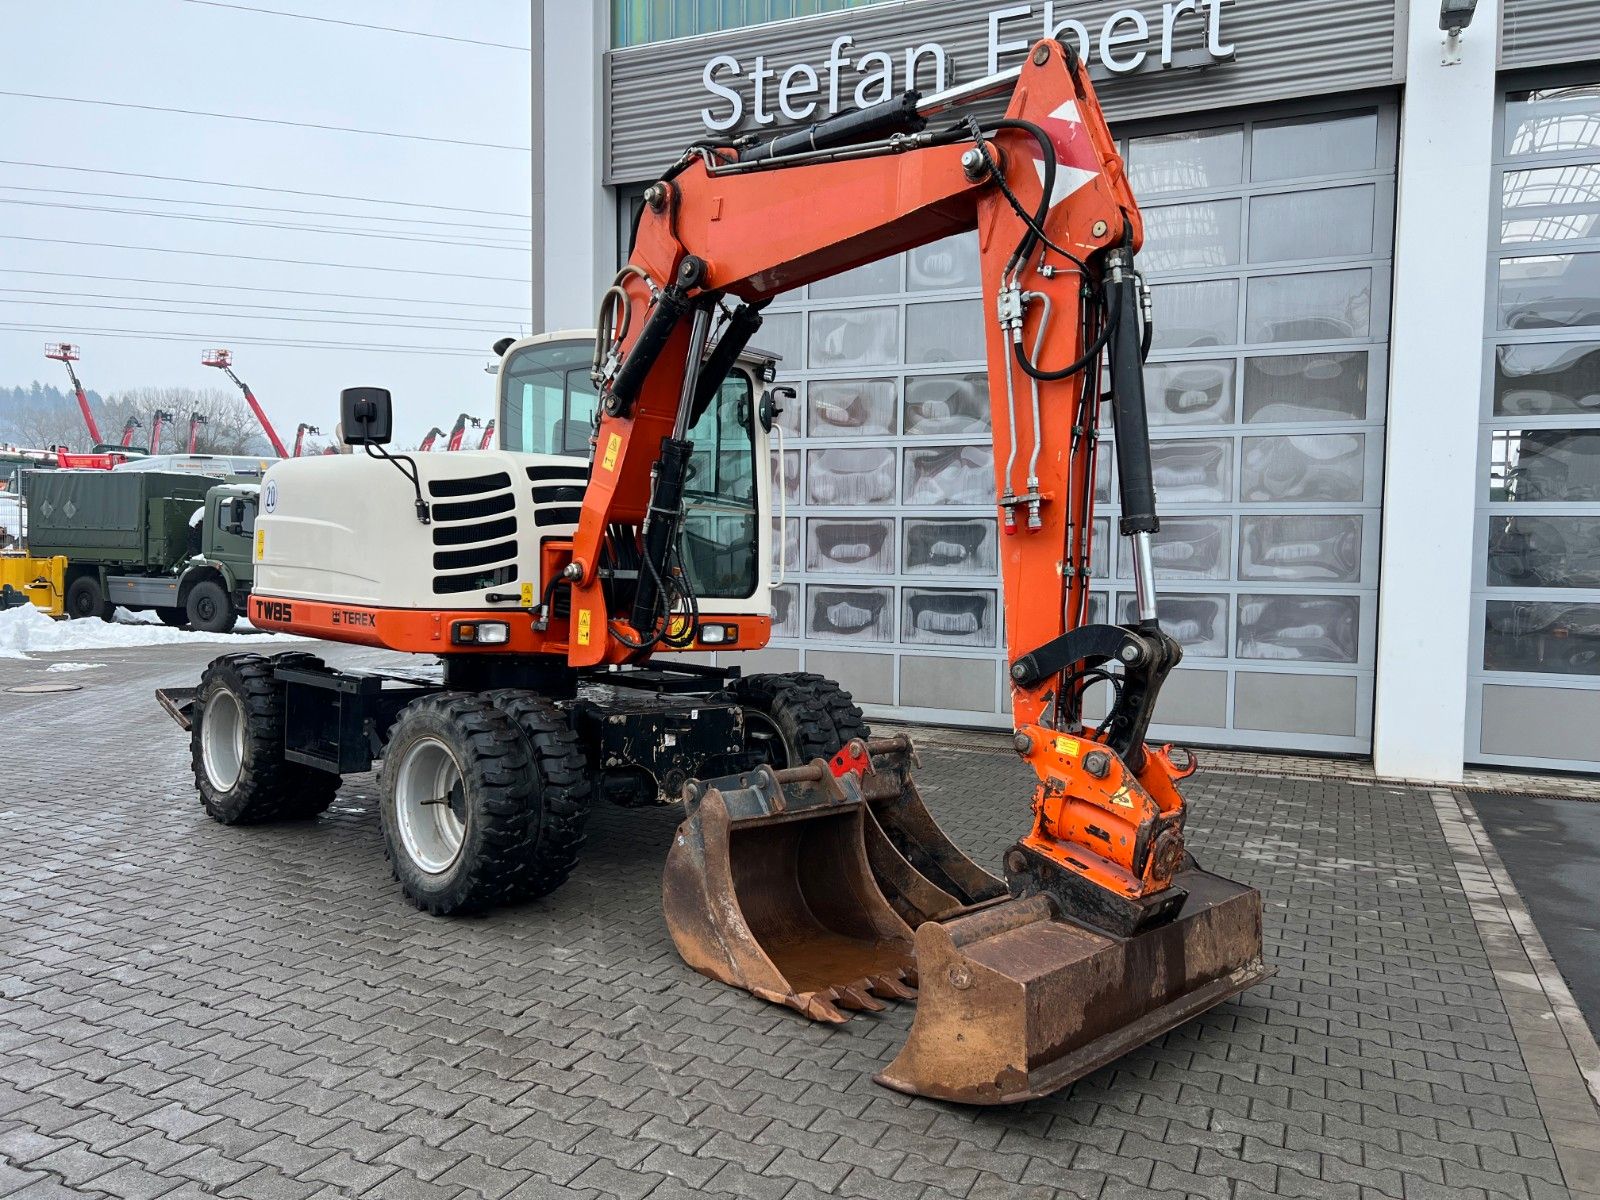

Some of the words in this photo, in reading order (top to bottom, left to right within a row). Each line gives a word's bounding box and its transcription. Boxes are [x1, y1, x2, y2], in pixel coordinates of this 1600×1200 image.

[701, 35, 946, 131] Stefan
[987, 0, 1235, 76] Ebert
[266, 486, 276, 507] 20
[256, 600, 292, 623] TW85
[342, 611, 376, 627] TEREX
